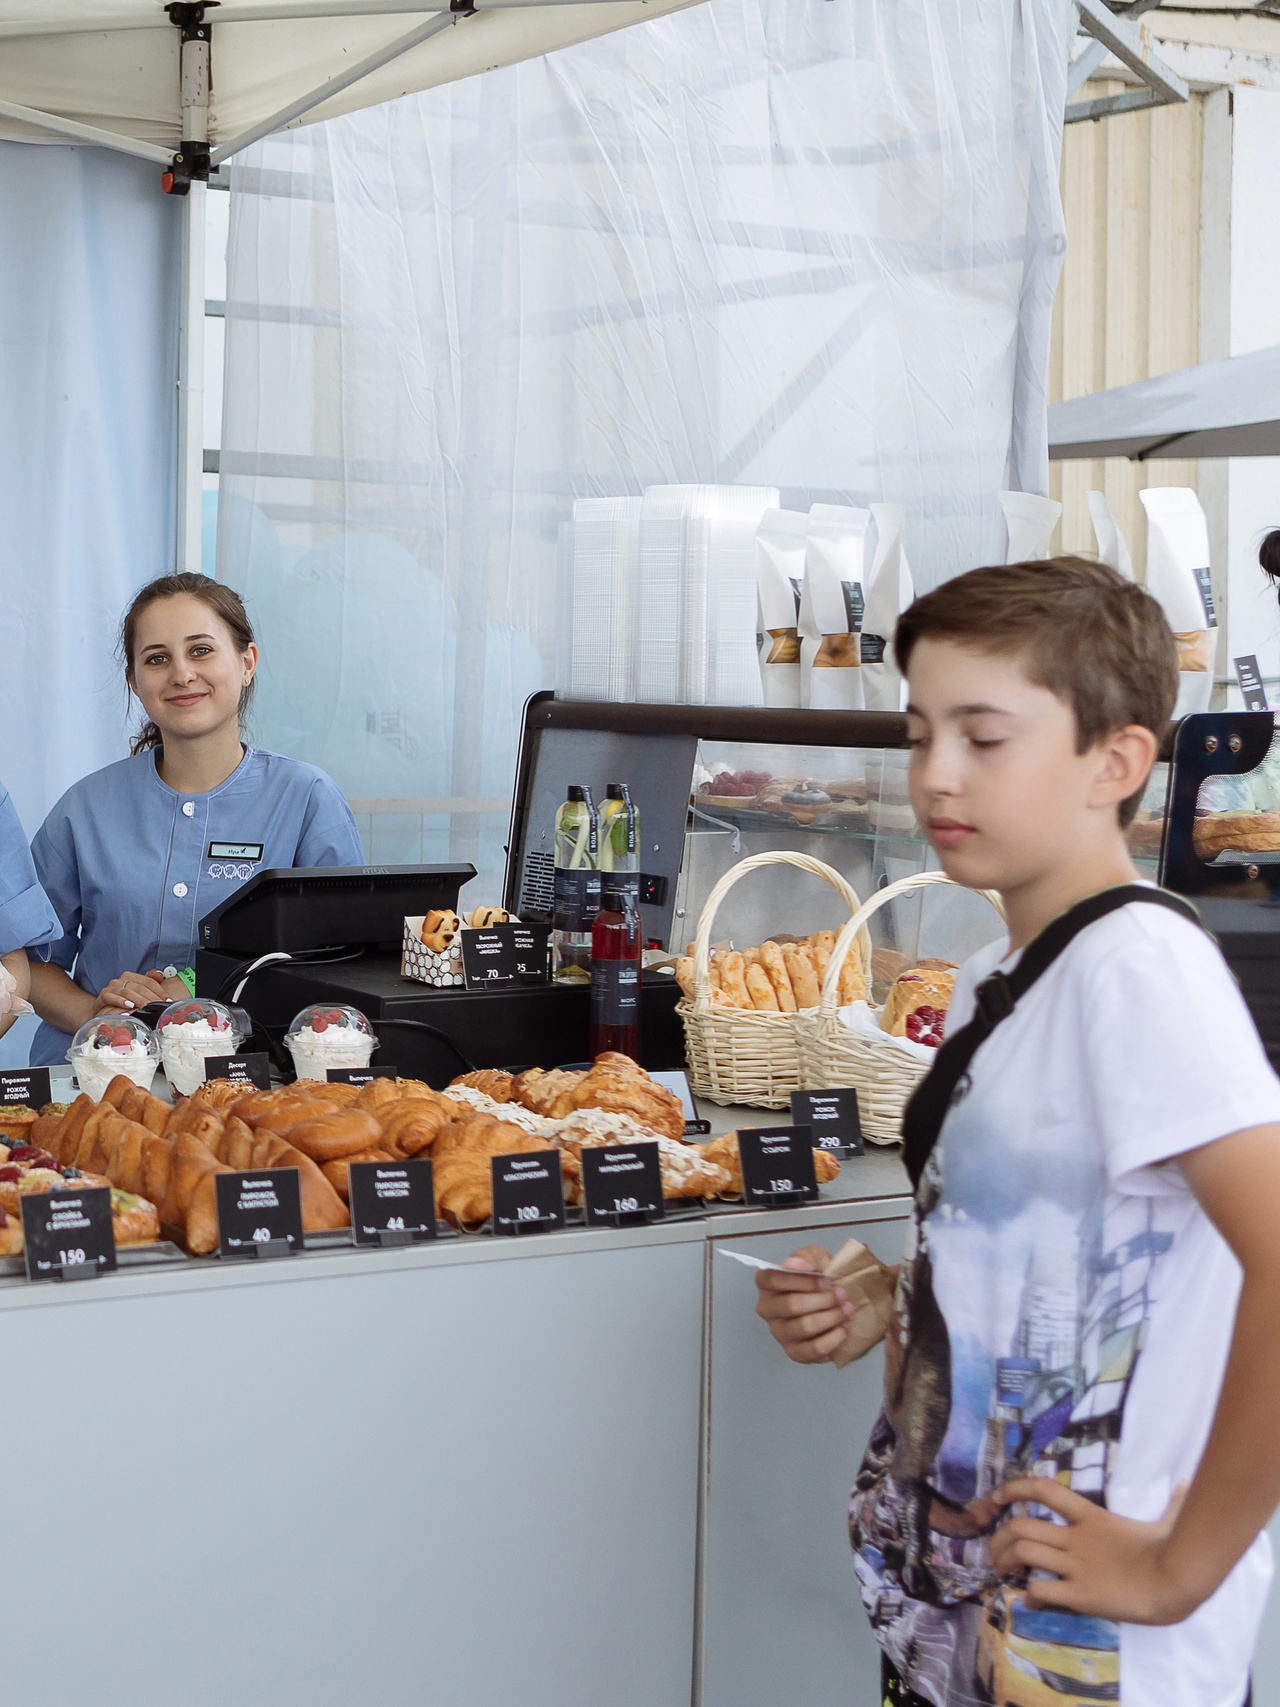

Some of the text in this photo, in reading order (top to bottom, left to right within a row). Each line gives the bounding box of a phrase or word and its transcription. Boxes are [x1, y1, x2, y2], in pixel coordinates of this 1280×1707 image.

[486, 969, 499, 978] 70
[1, 1077, 30, 1085] Пирожные
[4, 1091, 30, 1100] ЯГОДНЫЙ
[818, 1136, 841, 1148] 290
[769, 1179, 793, 1192] 150
[613, 1197, 638, 1212] 160
[516, 1205, 540, 1220] 100
[386, 1216, 405, 1231] 44
[252, 1227, 271, 1242] 40
[59, 1248, 86, 1265] 150
